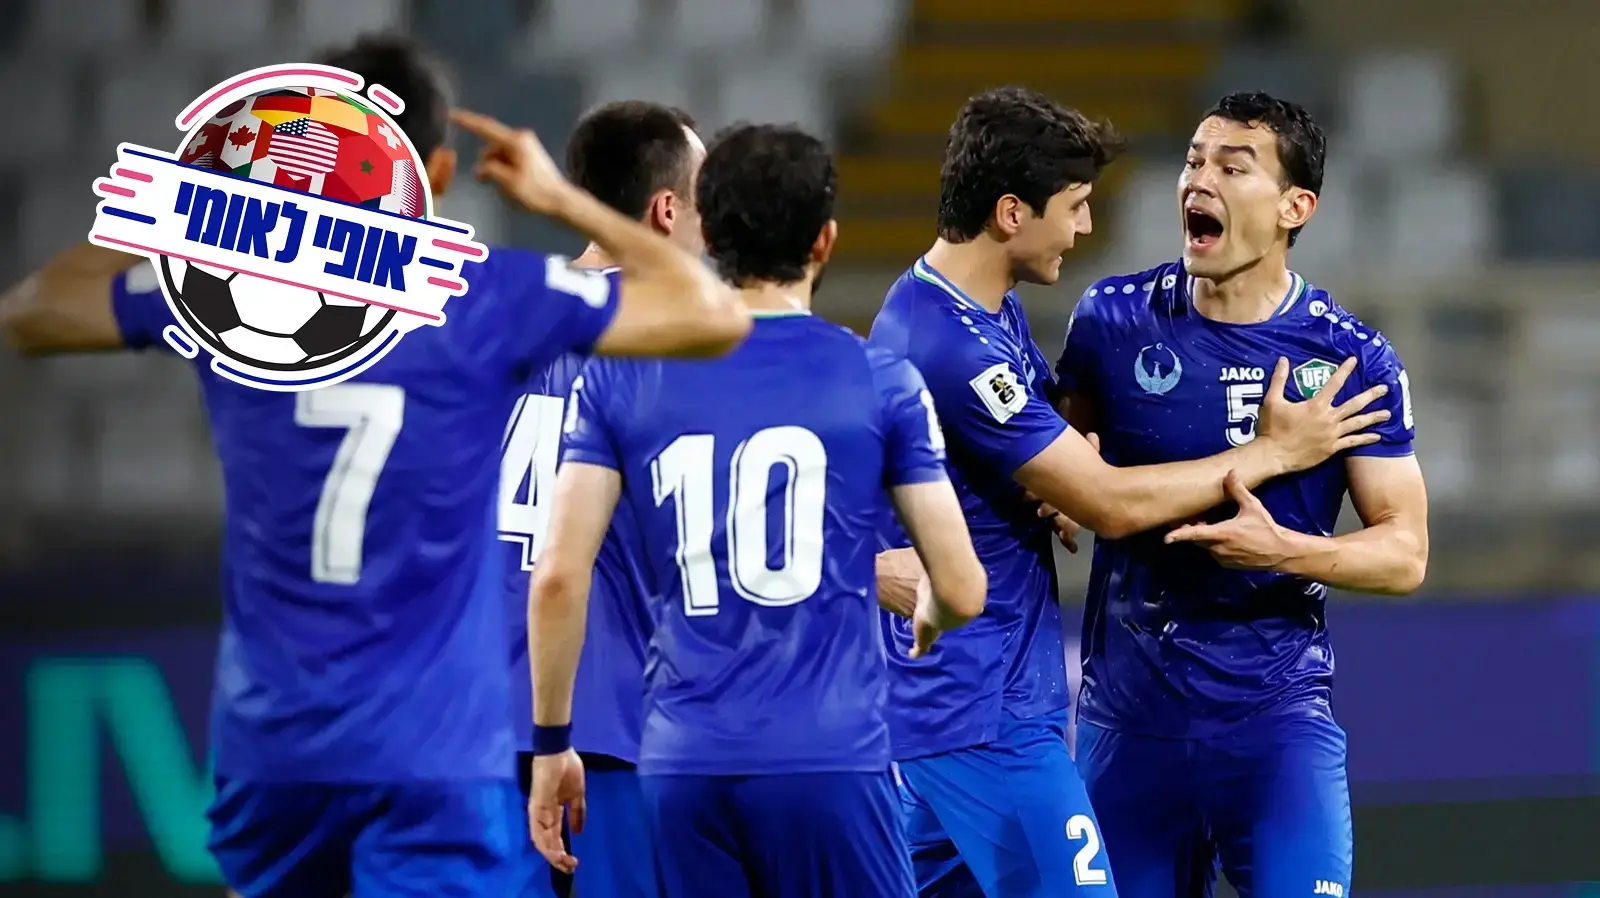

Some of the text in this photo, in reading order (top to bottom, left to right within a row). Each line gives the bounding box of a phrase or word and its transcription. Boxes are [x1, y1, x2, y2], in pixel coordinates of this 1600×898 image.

[1219, 367, 1265, 381] JAKO
[1225, 383, 1263, 448] 5
[294, 384, 404, 585] 7
[497, 393, 564, 571] 4
[652, 426, 827, 617] 10
[1066, 814, 1107, 886] 2
[1313, 879, 1343, 897] JAKO
